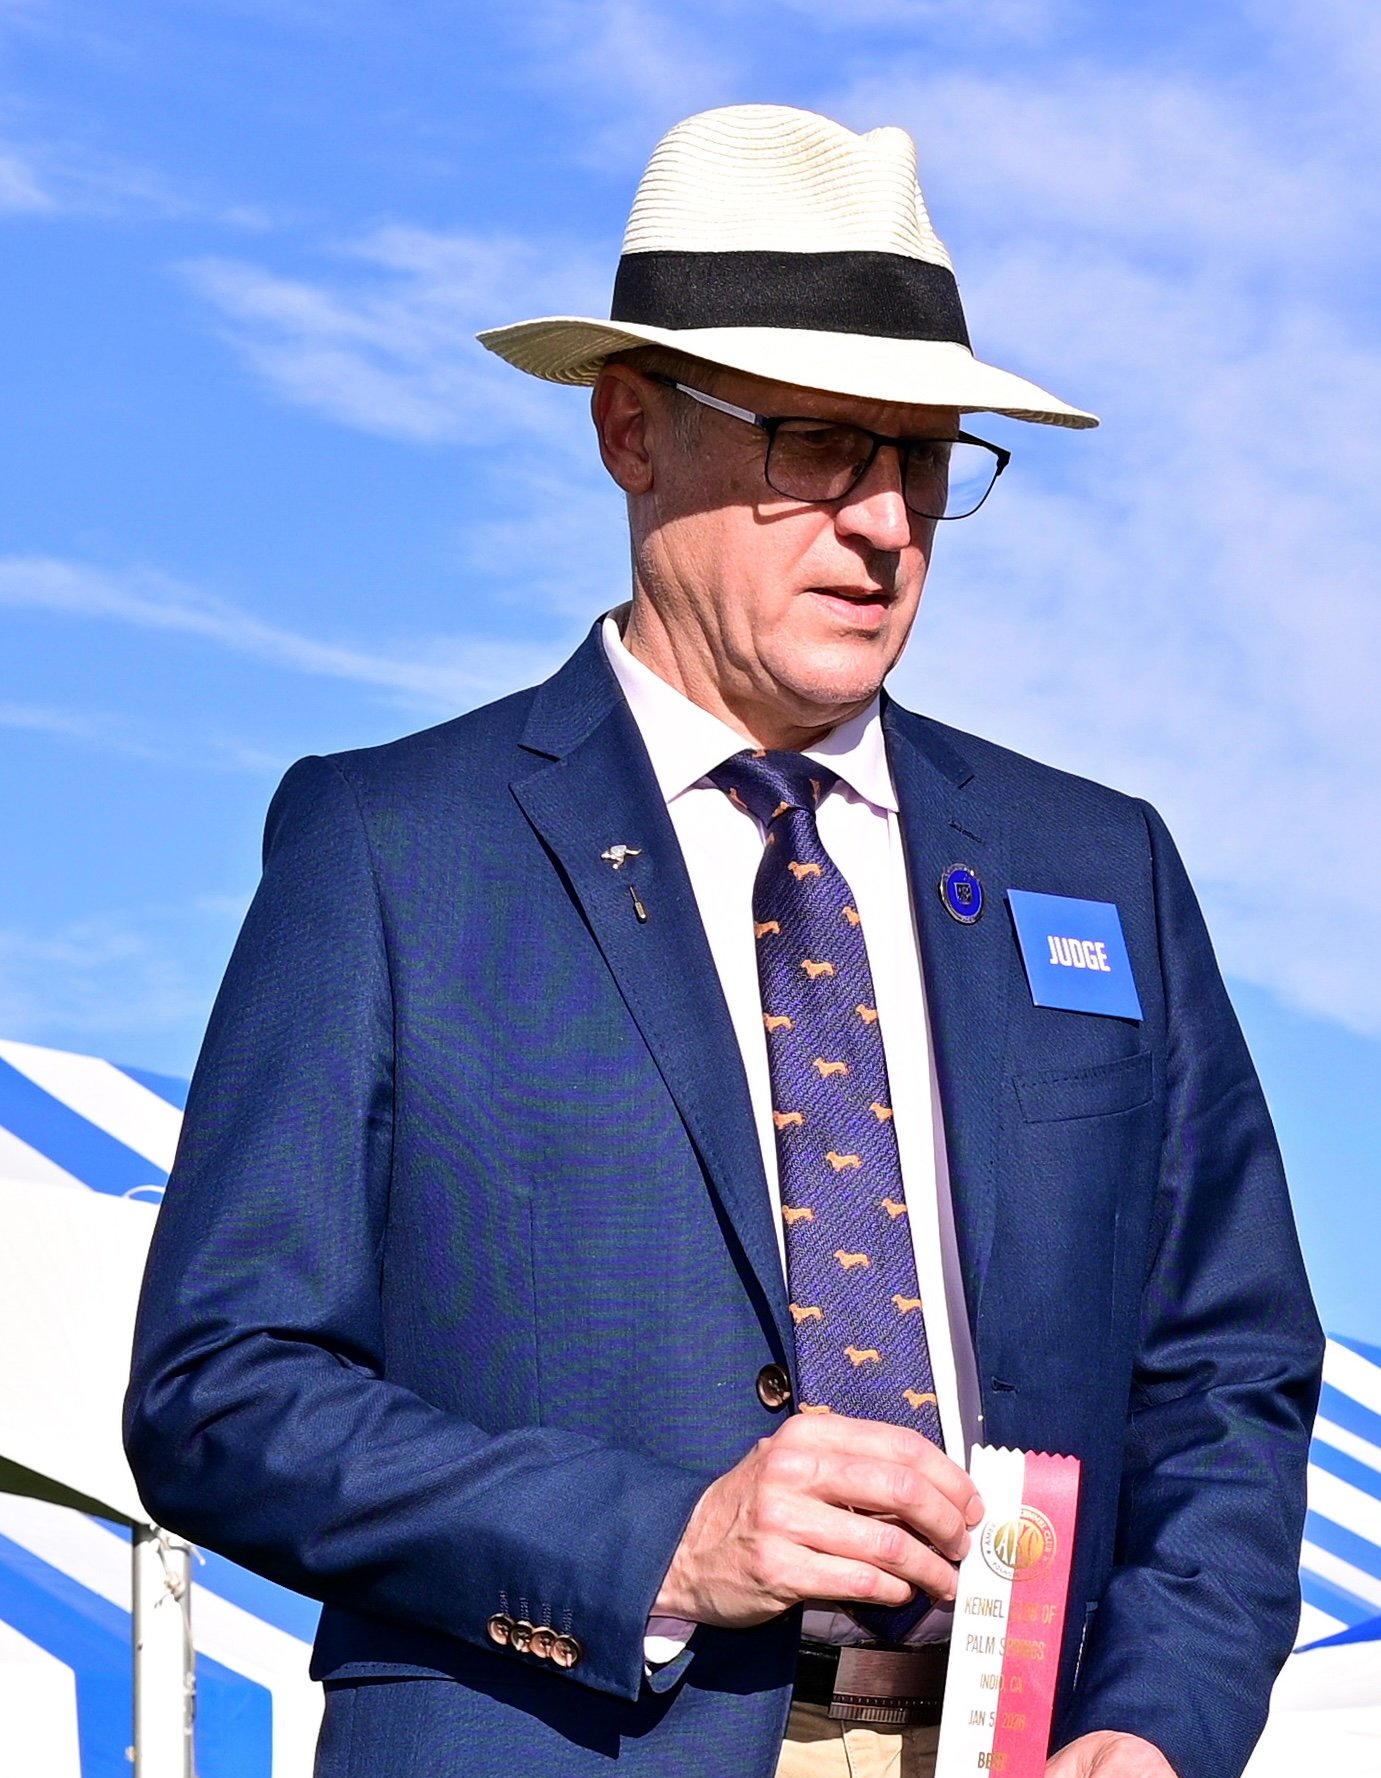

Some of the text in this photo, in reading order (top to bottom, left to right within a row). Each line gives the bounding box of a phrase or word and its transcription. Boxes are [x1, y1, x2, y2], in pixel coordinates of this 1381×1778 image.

[1047, 935, 1111, 972] JUDGE
[964, 1596, 1004, 1618] KENNEL
[1041, 1604, 1057, 1625] OF
[965, 1633, 996, 1655] PALM
[968, 1709, 986, 1726] JAN
